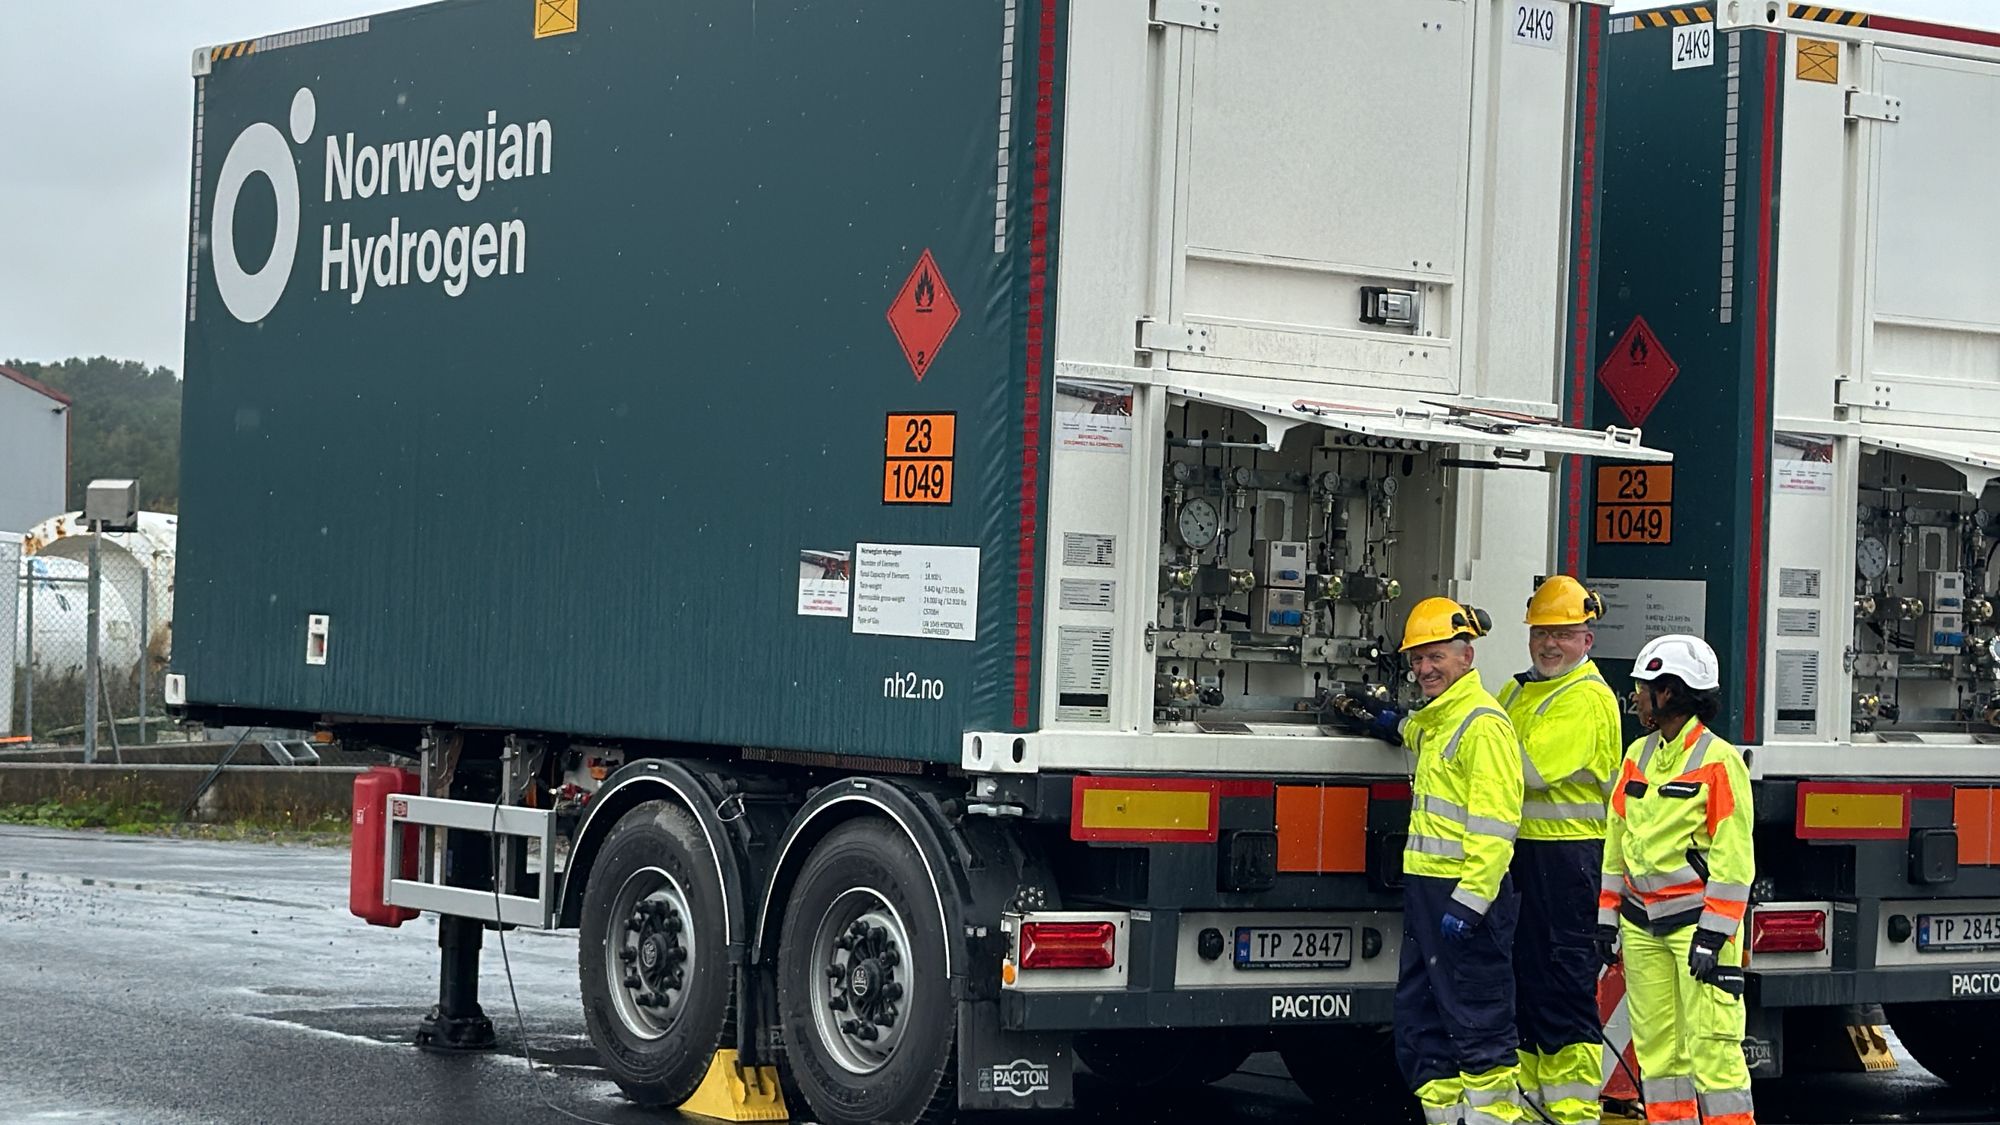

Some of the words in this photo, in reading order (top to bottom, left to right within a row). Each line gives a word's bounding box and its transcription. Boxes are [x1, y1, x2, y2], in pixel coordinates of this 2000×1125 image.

[1517, 6, 1554, 41] 24K9
[1677, 29, 1710, 62] 24K9
[325, 110, 552, 202] Norwegian
[321, 217, 526, 304] Hydrogen
[917, 351, 925, 365] 2
[905, 419, 932, 453] 23
[892, 464, 944, 500] 1049
[1618, 470, 1648, 500] 23
[1606, 508, 1662, 540] 1049
[862, 548, 882, 556] Norwegian
[884, 672, 944, 700] nh2.no
[1936, 918, 1954, 940] TP
[1963, 918, 2000, 940] 2845
[1258, 933, 1282, 958] TP
[1292, 932, 1343, 958] 2847
[1952, 974, 2000, 996] PACTO
[1272, 994, 1350, 1018] PACTON
[994, 1070, 1048, 1086] PACTON
